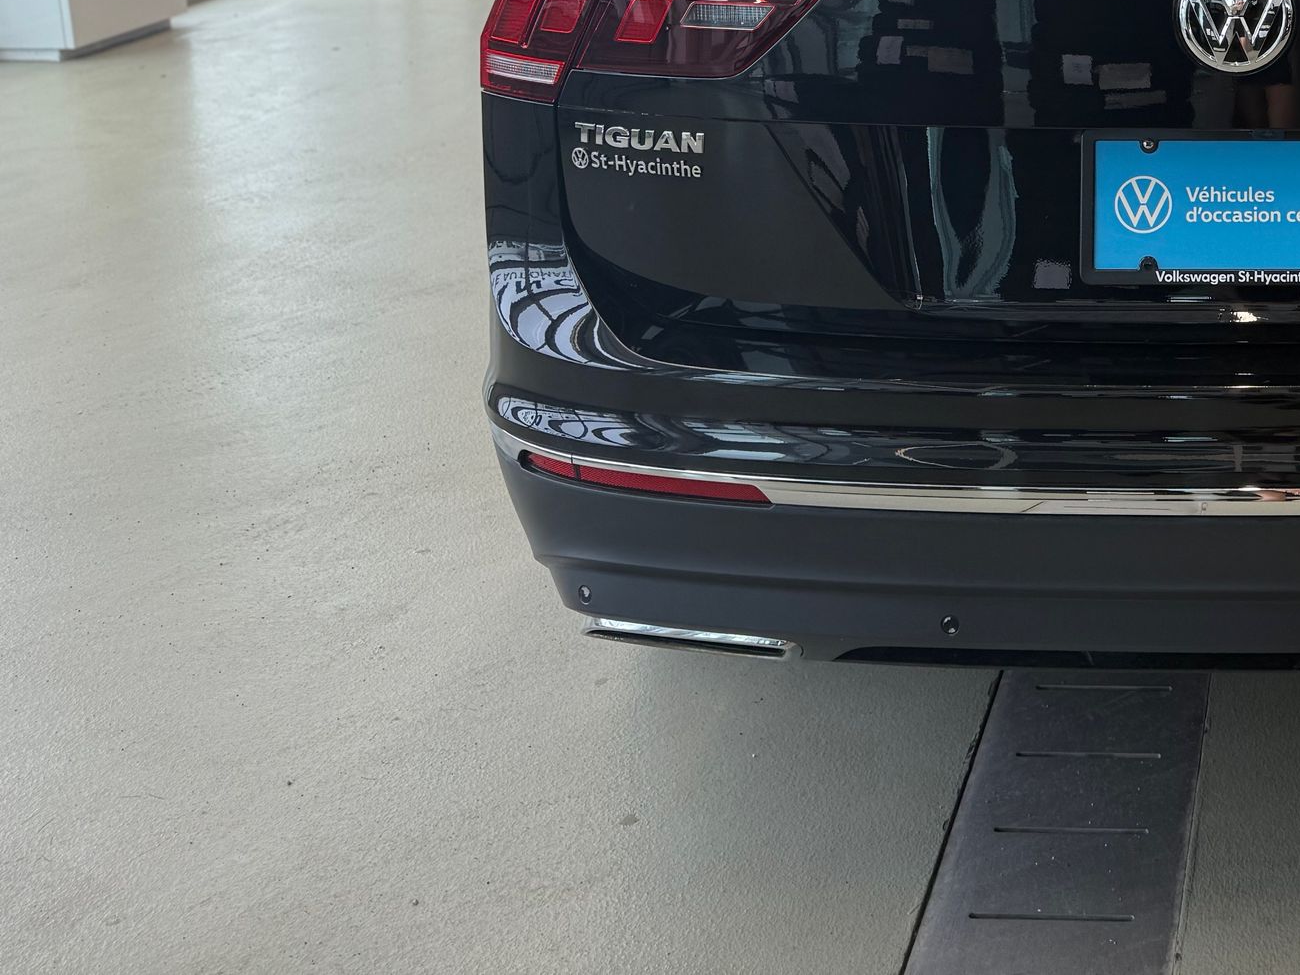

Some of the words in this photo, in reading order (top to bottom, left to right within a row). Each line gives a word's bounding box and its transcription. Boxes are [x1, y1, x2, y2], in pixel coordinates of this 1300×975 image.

[574, 121, 705, 154] TIGUAN
[590, 151, 702, 178] St-Hyacinthe
[1185, 186, 1275, 203] Véhicules
[1185, 206, 1281, 223] d'occasion
[1155, 270, 1235, 285] Volkswagen
